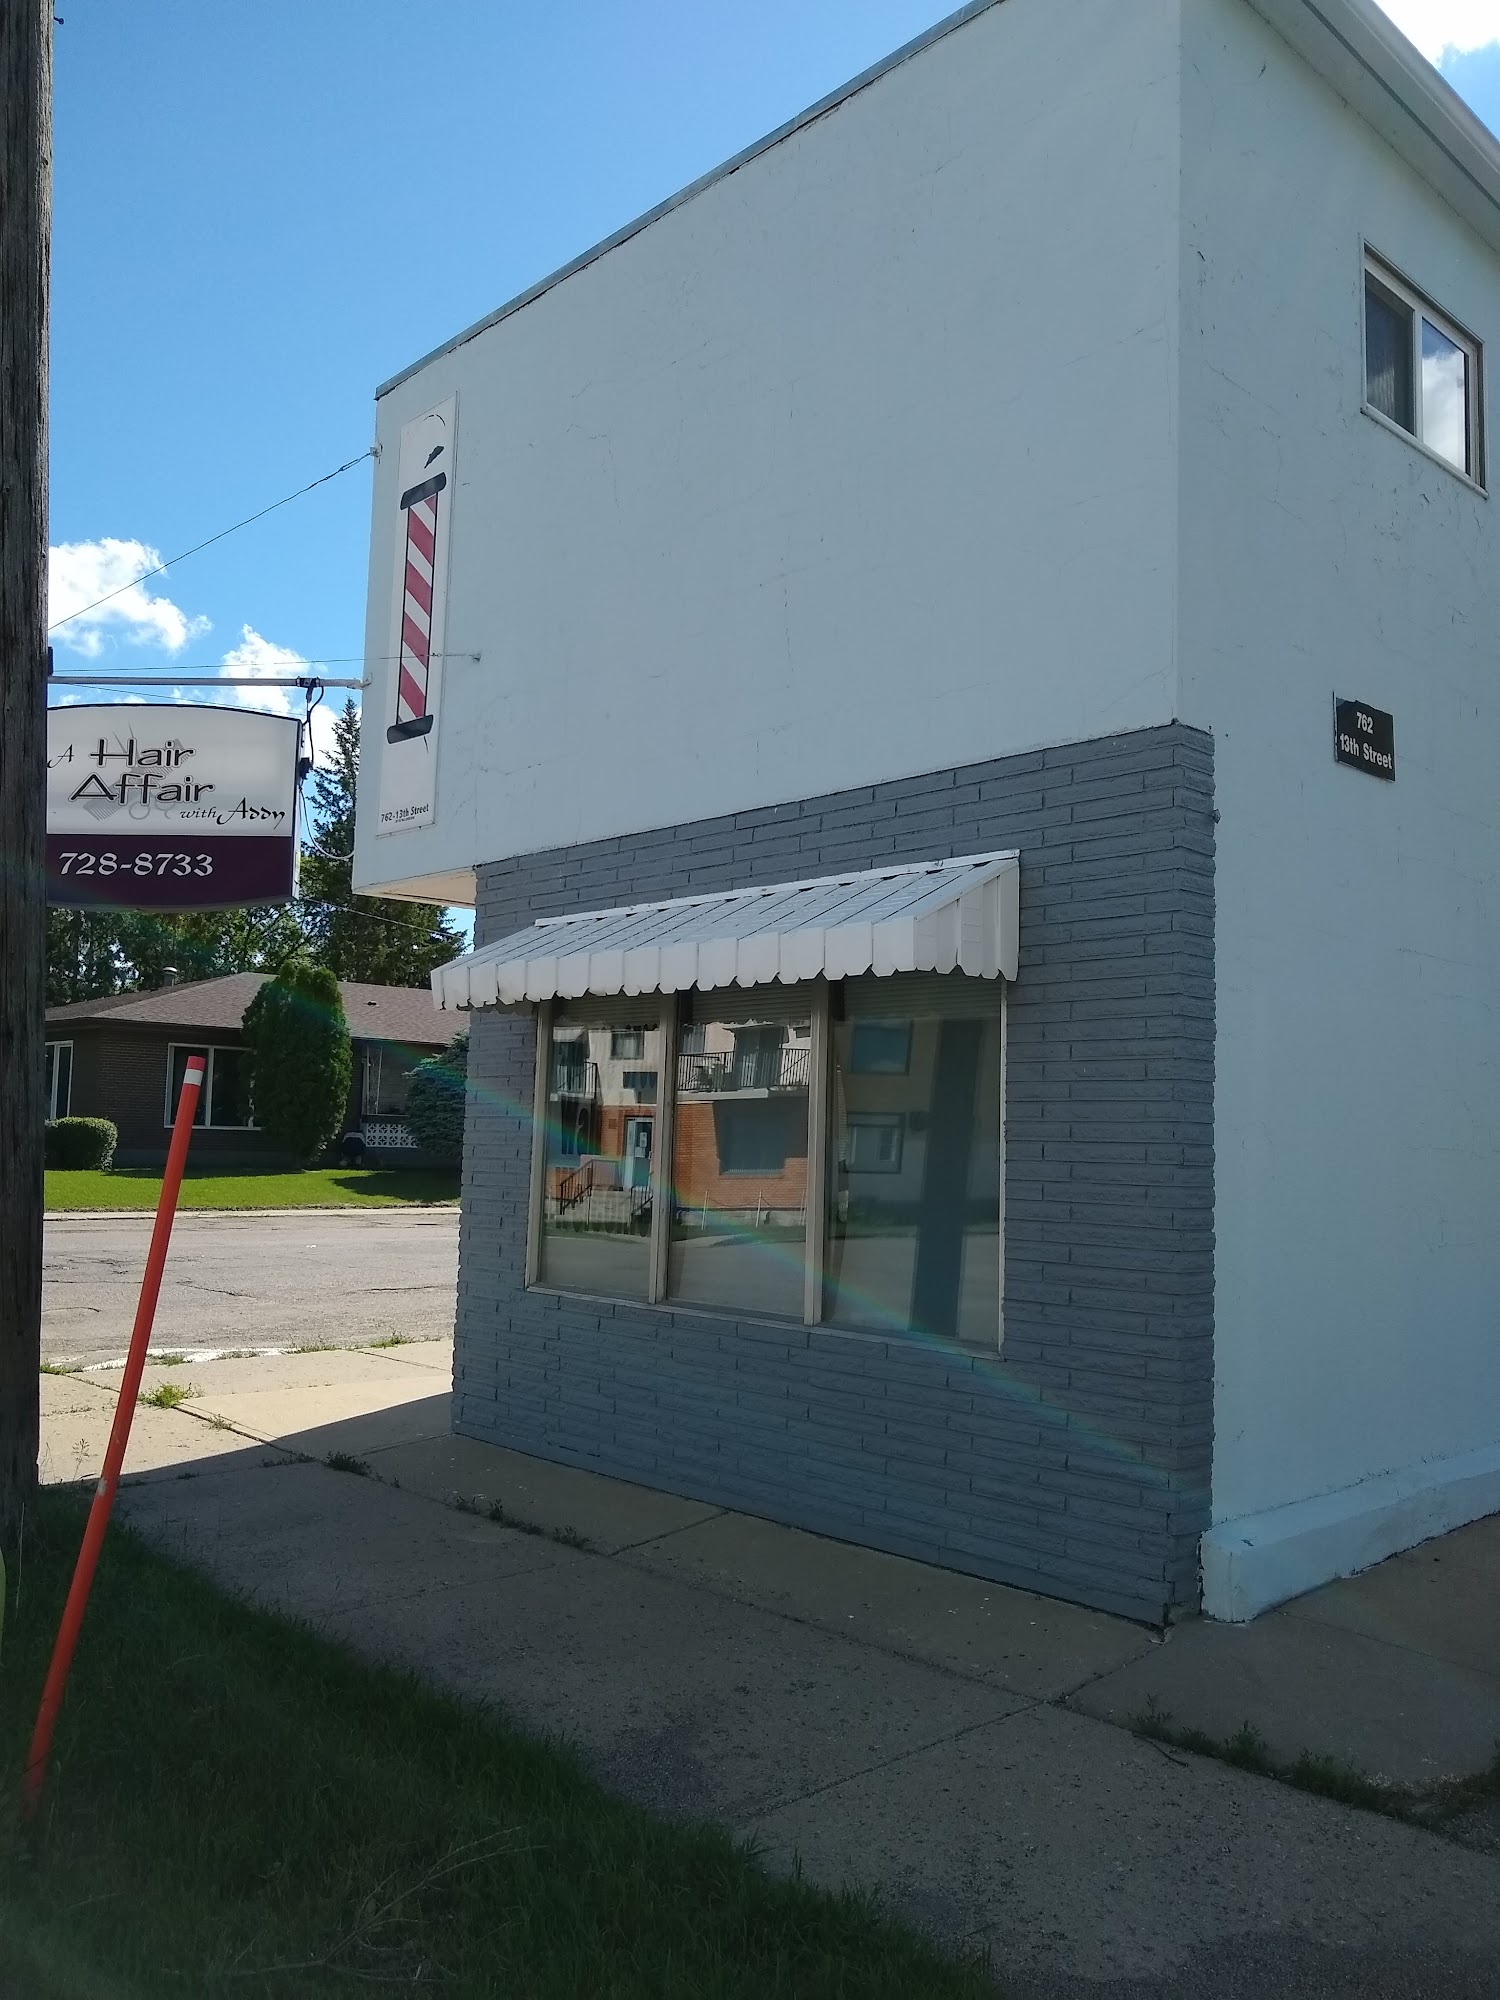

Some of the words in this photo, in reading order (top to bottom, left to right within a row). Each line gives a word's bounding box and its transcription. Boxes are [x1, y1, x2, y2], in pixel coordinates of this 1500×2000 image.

[1356, 711, 1373, 734] 762
[47, 744, 75, 768] A
[89, 737, 195, 767] Hair
[1340, 733, 1360, 757] 13th
[1363, 742, 1392, 769] Street
[69, 773, 215, 804] Affair
[180, 806, 217, 820] with
[216, 797, 286, 829] Addy
[410, 804, 429, 815] Street
[59, 852, 214, 877] 728-8733
